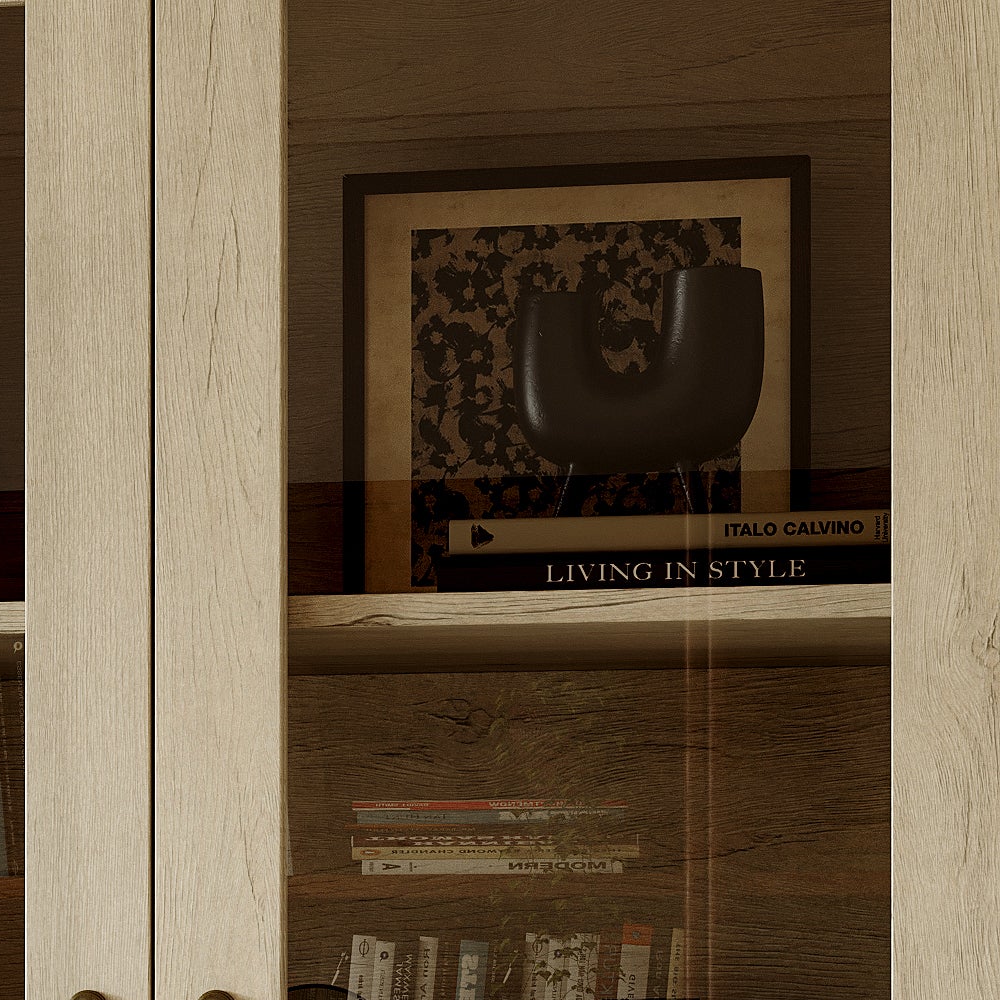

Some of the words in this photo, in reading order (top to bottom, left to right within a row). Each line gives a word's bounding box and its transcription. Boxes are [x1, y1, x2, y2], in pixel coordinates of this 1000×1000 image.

[725, 521, 777, 538] ITALO
[783, 519, 866, 536] CALVINO
[546, 562, 653, 583] LIVING
[665, 561, 699, 581] IN
[709, 558, 809, 580] STYLE
